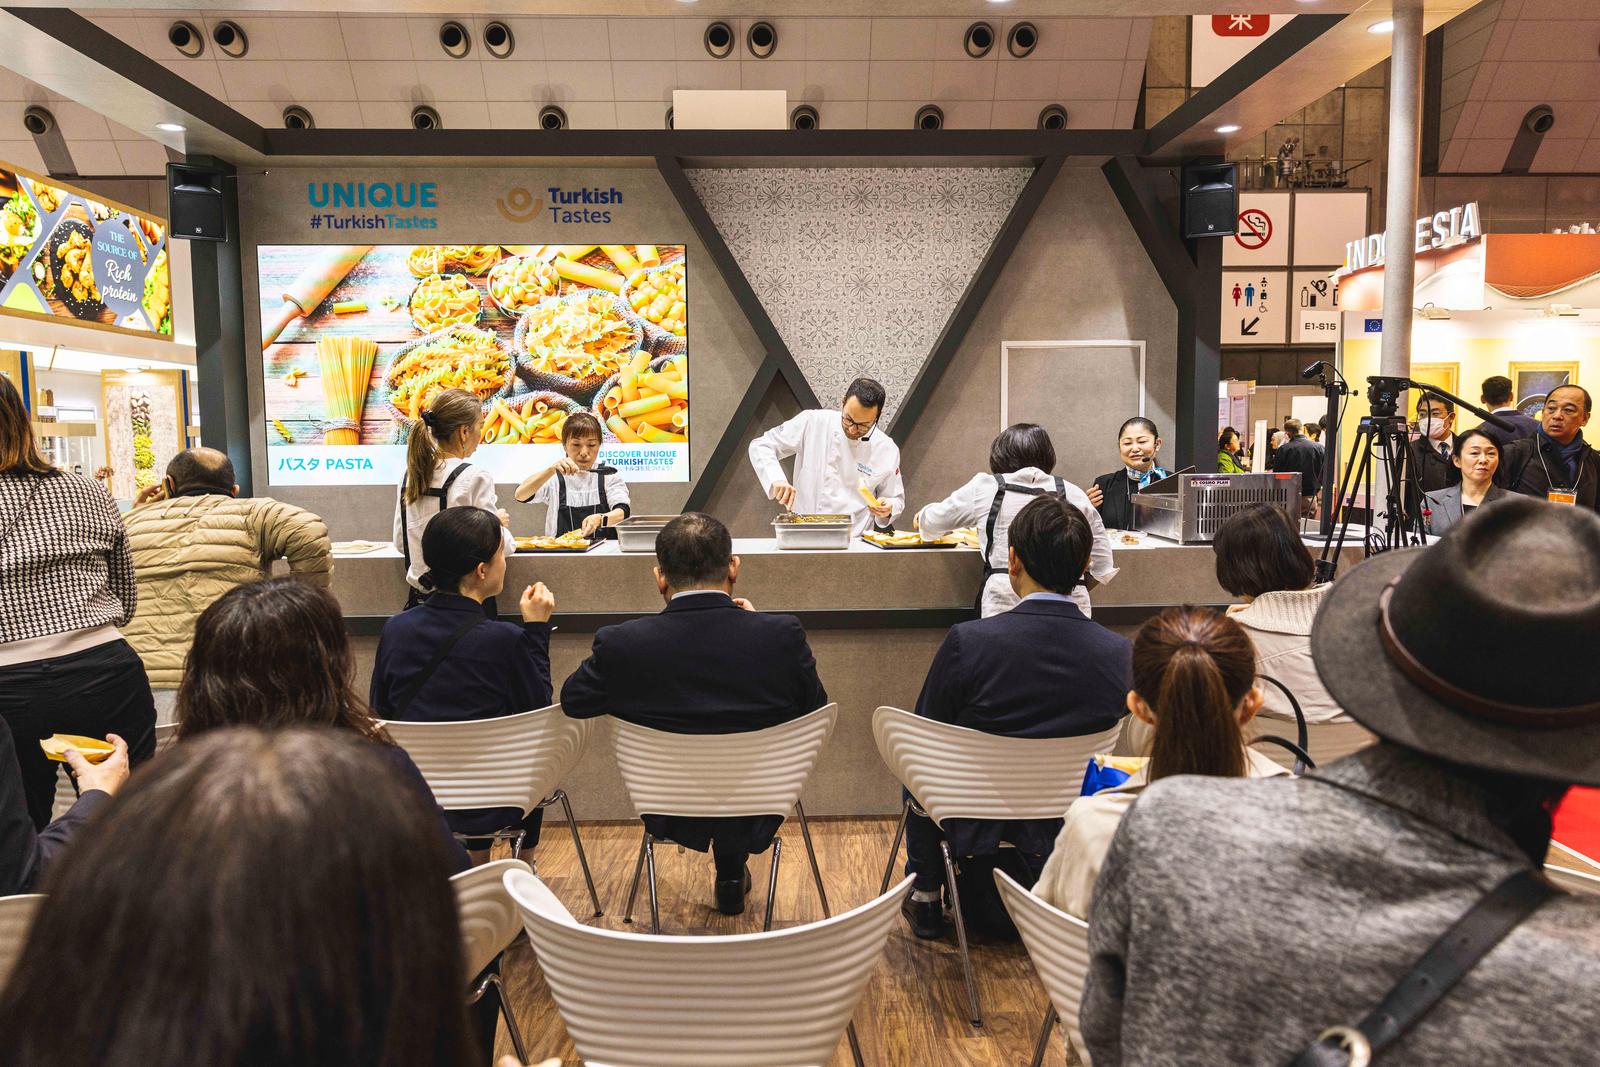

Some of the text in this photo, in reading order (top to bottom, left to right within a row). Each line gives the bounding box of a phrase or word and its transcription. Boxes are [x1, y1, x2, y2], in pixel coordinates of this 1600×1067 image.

[308, 182, 438, 208] UNIQUE
[548, 187, 623, 204] Turkish
[310, 214, 438, 230] #TurkishTastes
[549, 207, 611, 224] Tastes
[110, 231, 125, 243] THE
[1345, 201, 1481, 272] INDESIA
[97, 241, 138, 260] SOURCE OF
[105, 259, 132, 283] Rich
[100, 285, 138, 304] protein
[1305, 322, 1337, 331] E1-S15
[598, 450, 642, 458] DISCOVER
[326, 458, 373, 470] PASTA
